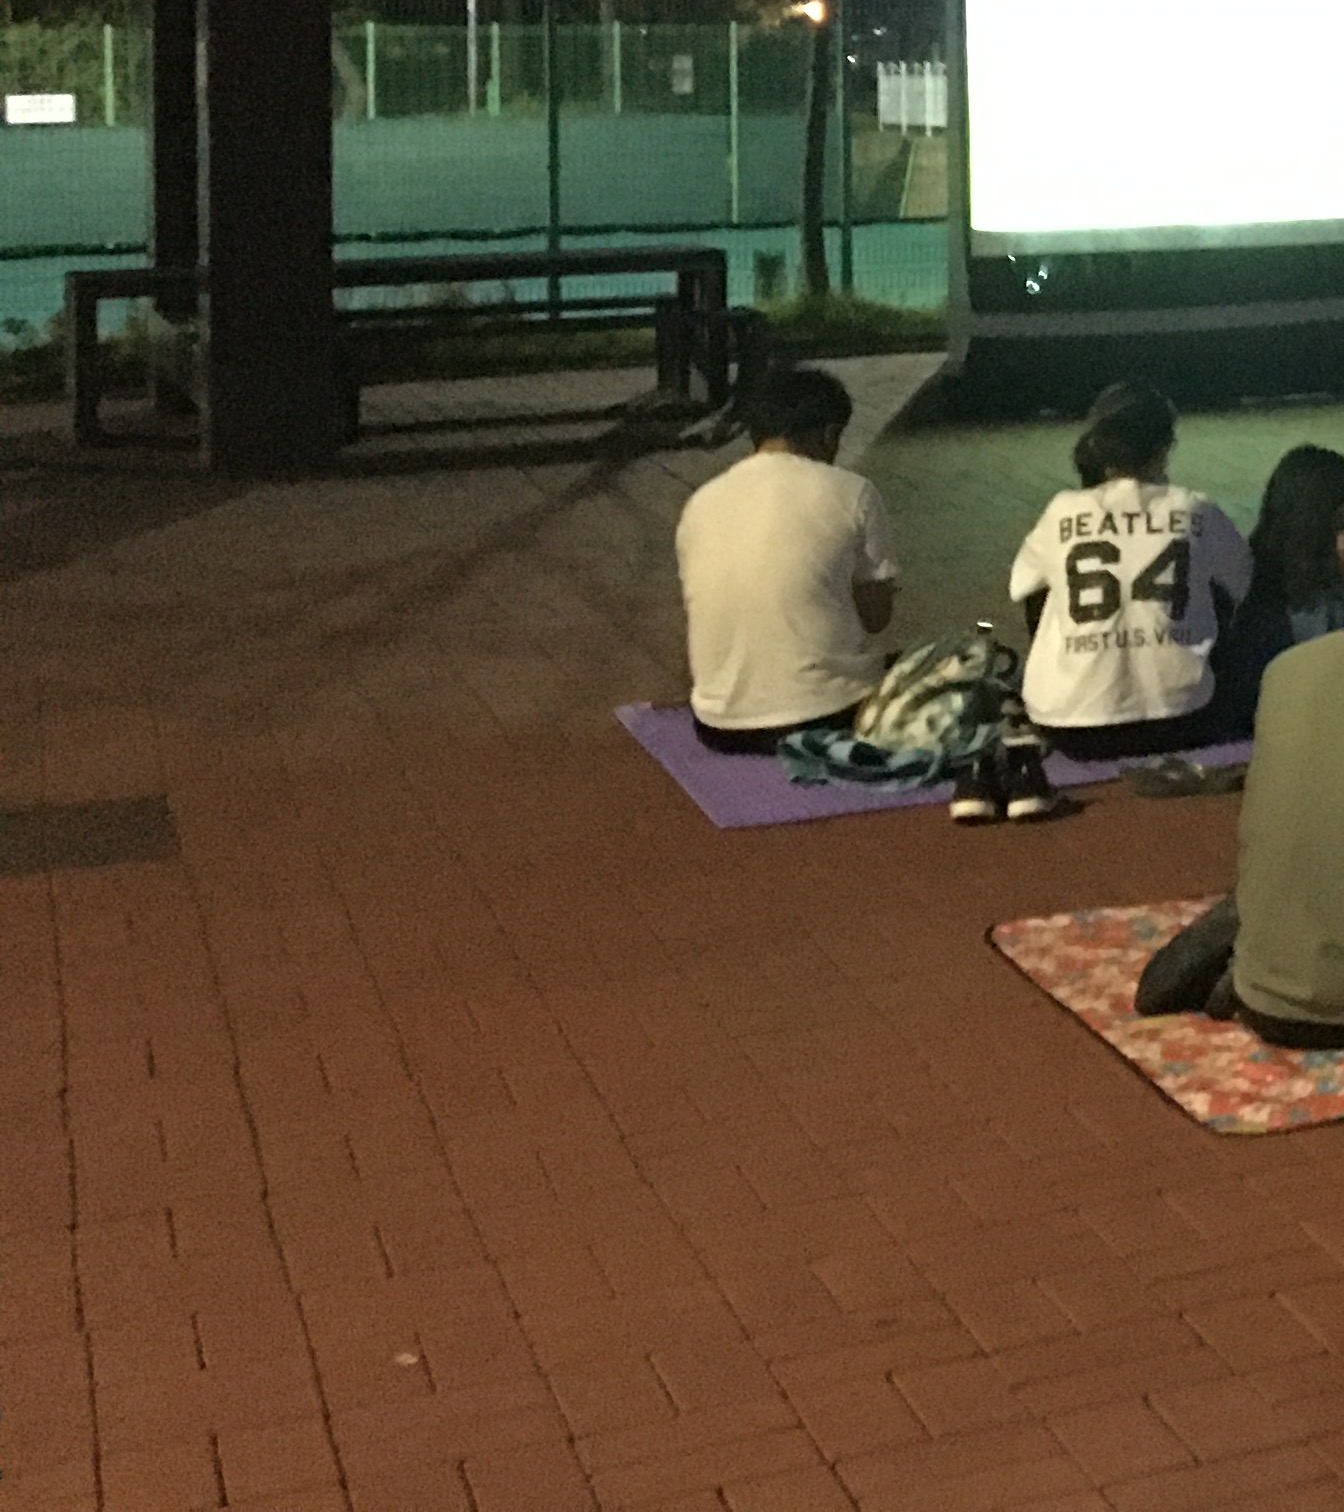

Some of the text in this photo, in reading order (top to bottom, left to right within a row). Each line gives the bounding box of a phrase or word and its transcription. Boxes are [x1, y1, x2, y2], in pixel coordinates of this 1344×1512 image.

[1059, 510, 1204, 543] BEATLES
[1066, 539, 1191, 624] 64
[1065, 631, 1110, 655] FIRST
